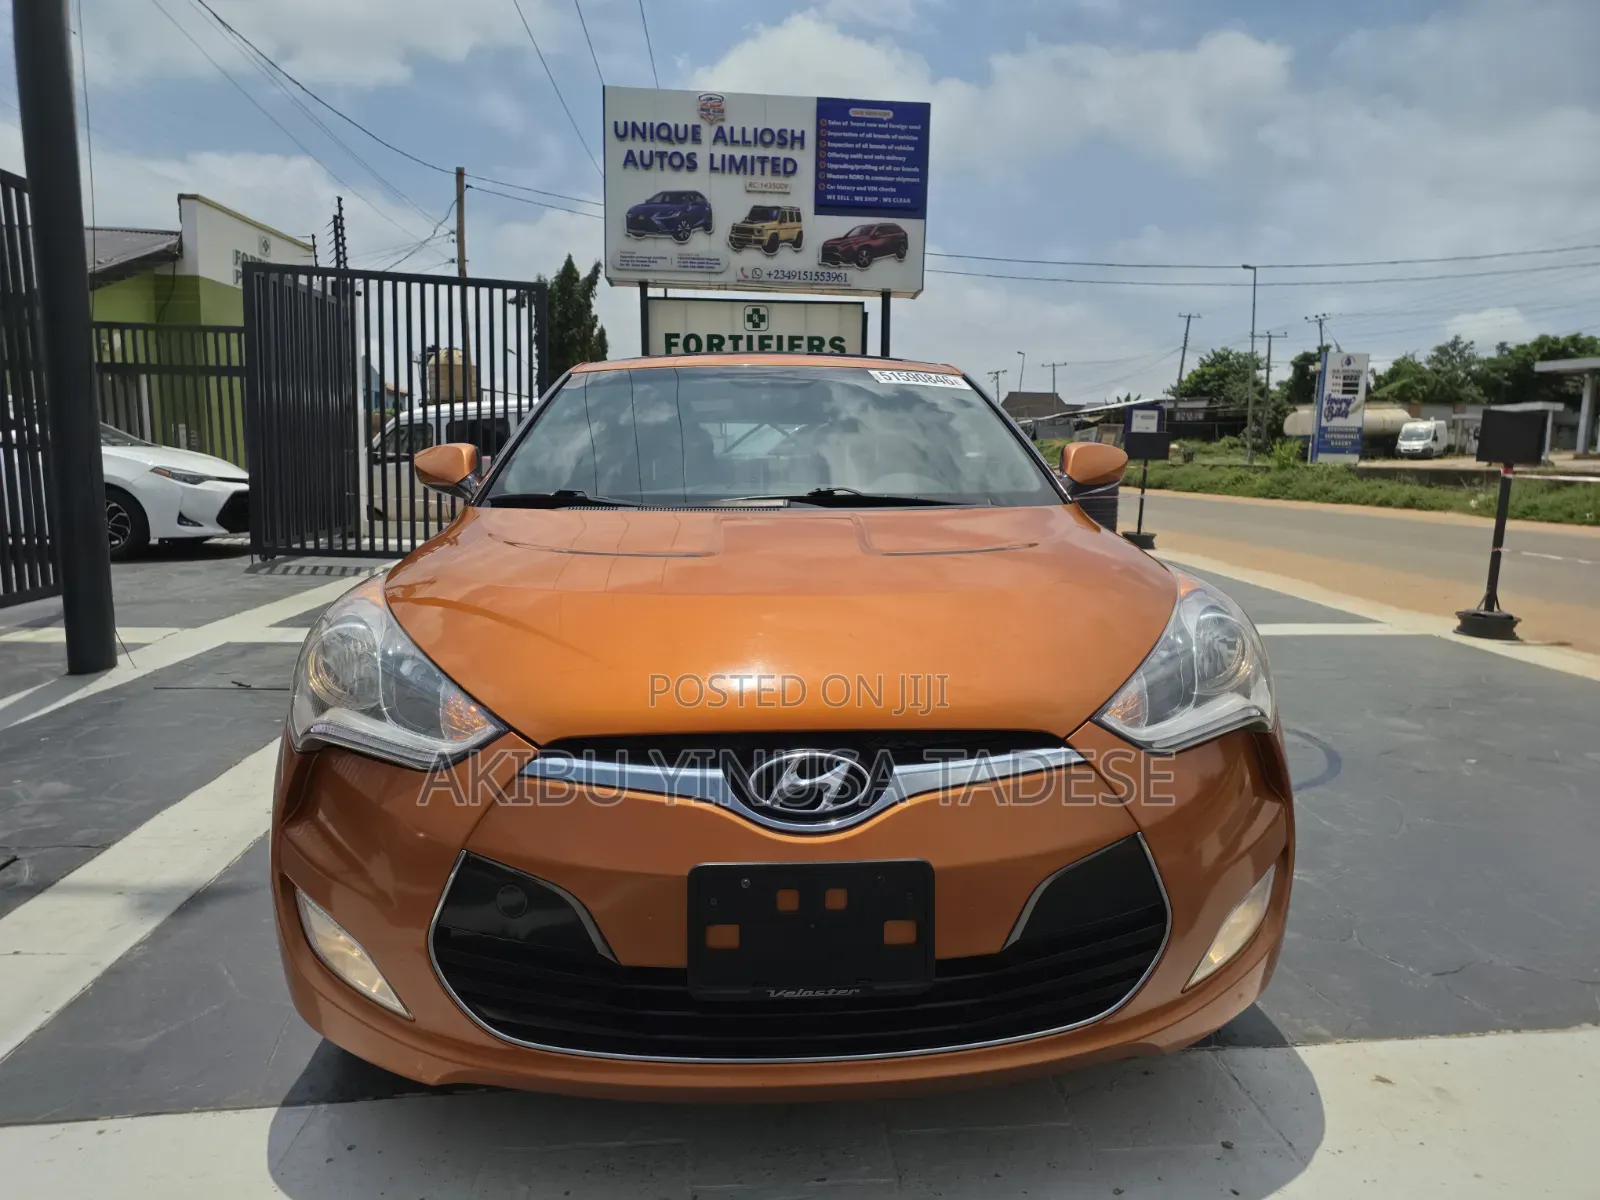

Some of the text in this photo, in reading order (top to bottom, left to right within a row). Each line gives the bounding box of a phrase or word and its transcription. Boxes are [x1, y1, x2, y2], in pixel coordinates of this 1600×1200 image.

[614, 120, 805, 150] UNIQUE ALLIOSH
[623, 149, 798, 177] AUTOS LIMITED
[766, 269, 848, 283] +2349151553961
[664, 332, 847, 355] FORTIFIERS
[765, 988, 860, 998] Veloster
